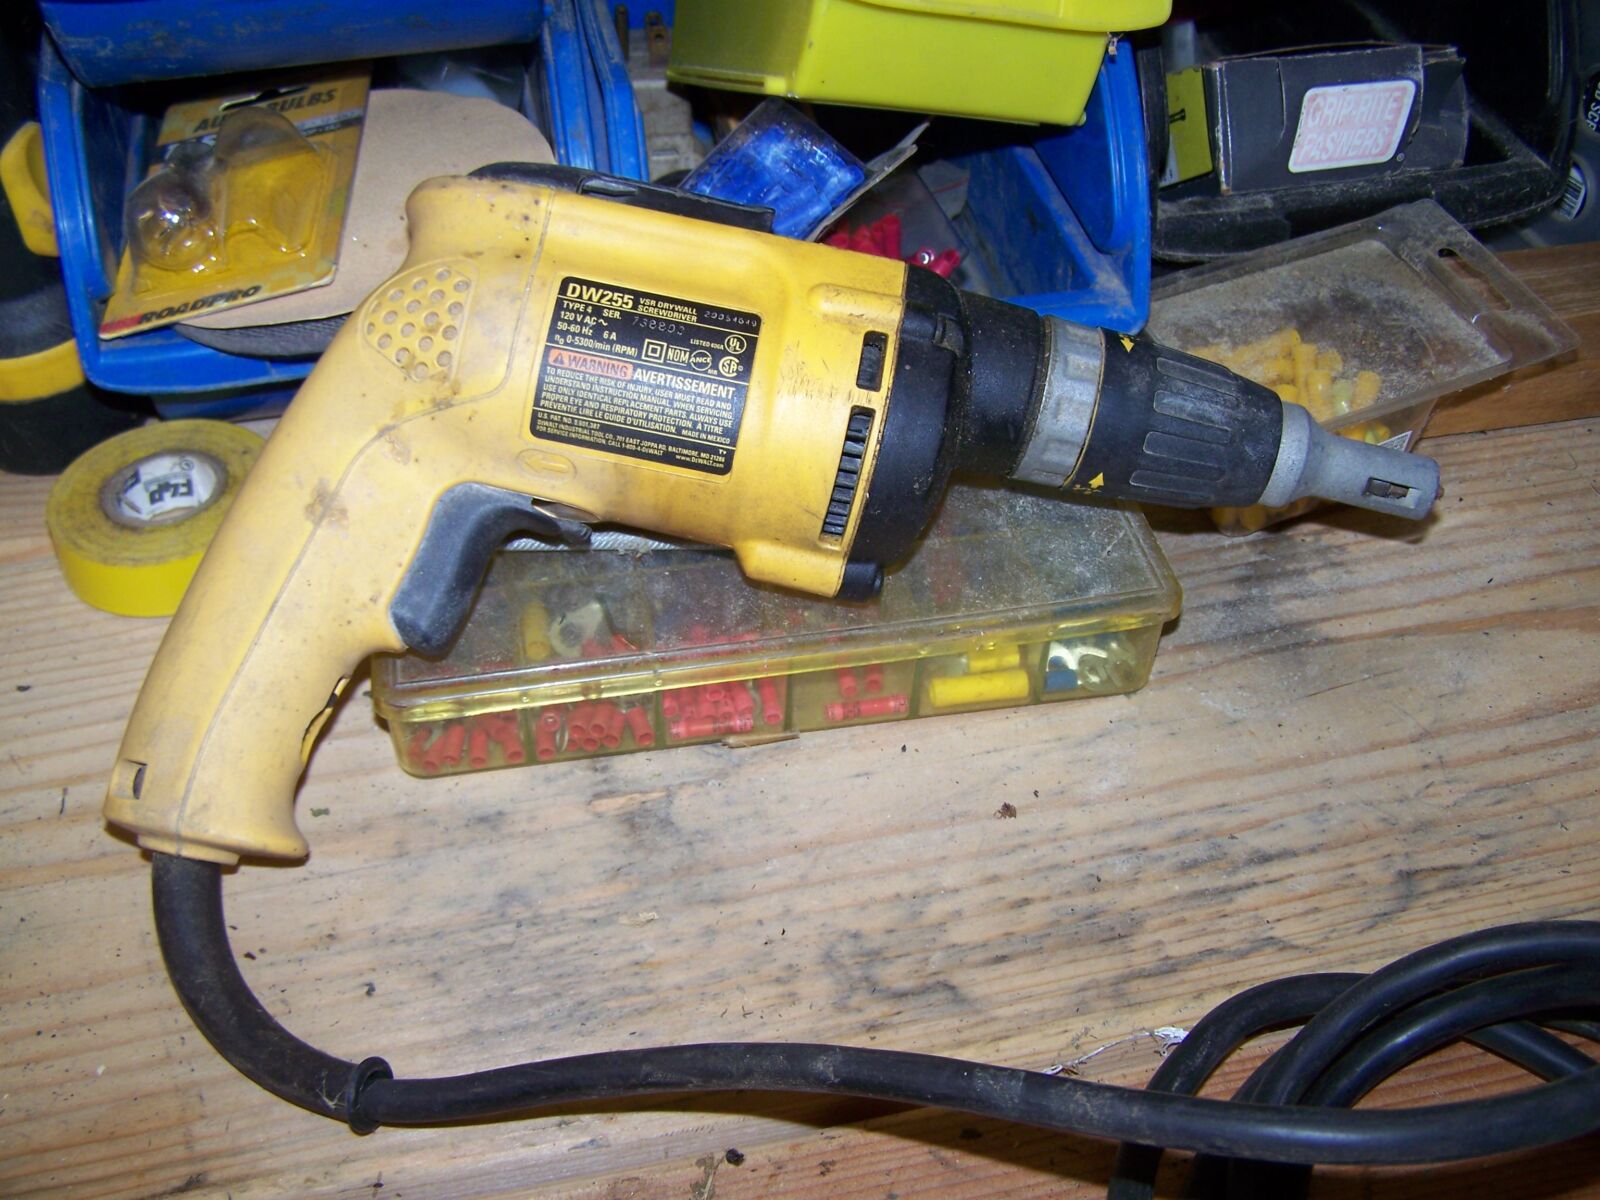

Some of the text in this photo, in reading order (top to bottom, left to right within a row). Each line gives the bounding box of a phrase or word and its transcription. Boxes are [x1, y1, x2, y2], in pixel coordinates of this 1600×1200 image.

[140, 285, 262, 324] ROADPRO
[566, 282, 635, 309] DW255
[562, 300, 586, 312] TYPE
[586, 305, 593, 314] 4
[602, 308, 623, 320] SER.
[637, 305, 697, 322] SCREWDRIVER
[639, 298, 698, 315] VSR DRYWALL
[559, 311, 597, 325] 120 V AC
[556, 321, 617, 340] 50-60 Hz 6 A
[611, 344, 638, 358] (RPM)
[728, 337, 742, 351] UL
[667, 348, 689, 363] NOM
[567, 355, 629, 378] WARNING
[544, 375, 591, 391] UNDERSTAND
[591, 384, 640, 400] INSTRUCTION
[672, 400, 695, 412] WHEN
[556, 368, 584, 381] REDUCE
[585, 374, 599, 384] THE
[599, 377, 616, 387] RISK
[654, 388, 673, 399] USER
[674, 392, 696, 403] MUST
[695, 397, 715, 407] READ
[715, 401, 732, 410] AND
[633, 368, 735, 399] AVERTISSEMENT
[541, 391, 569, 403] PROPER
[569, 397, 583, 406] EYE
[584, 400, 600, 409] AND
[600, 403, 647, 418] RESPIRATORY
[703, 424, 723, 434] TITRE
[543, 383, 557, 393] USE
[557, 386, 575, 396] ONLY
[576, 390, 612, 403] IDENTICAL
[613, 397, 664, 413] REPLACEMENT
[689, 412, 718, 425] ALWAYS
[718, 418, 732, 428] USE
[579, 407, 593, 417] LIRE
[604, 412, 625, 423] GUIDE
[681, 429, 698, 438] MADE
[707, 435, 730, 444] MEXICO
[591, 430, 604, 438] TOOL
[626, 437, 640, 445] EAST
[608, 440, 621, 448] CALL
